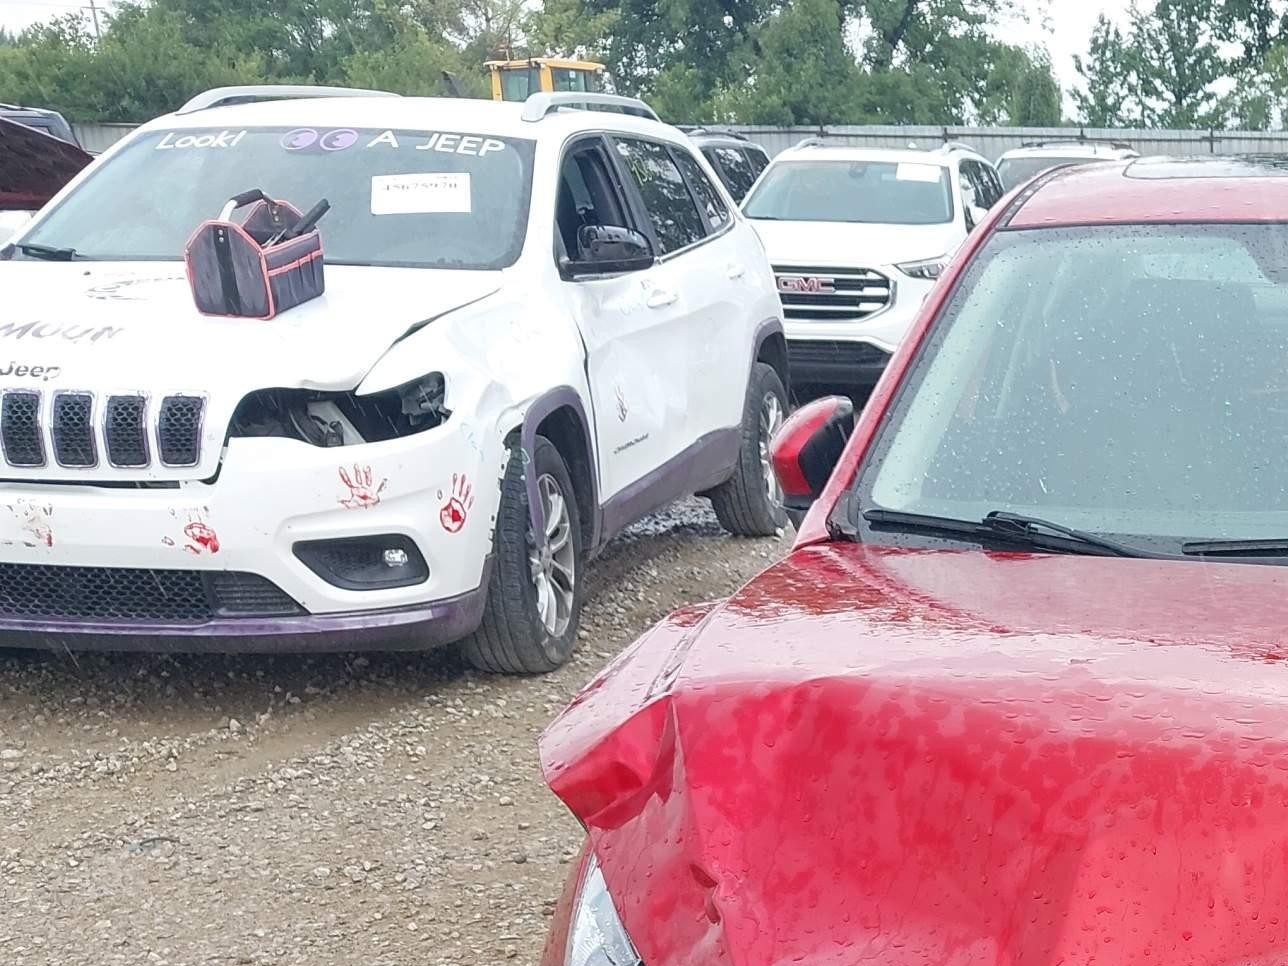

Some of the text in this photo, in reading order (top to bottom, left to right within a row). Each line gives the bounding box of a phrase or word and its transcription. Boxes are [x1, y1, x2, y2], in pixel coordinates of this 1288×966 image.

[155, 130, 506, 157] Look! A JEEP
[779, 276, 835, 293] GMC
[0, 361, 61, 381] Jeep
